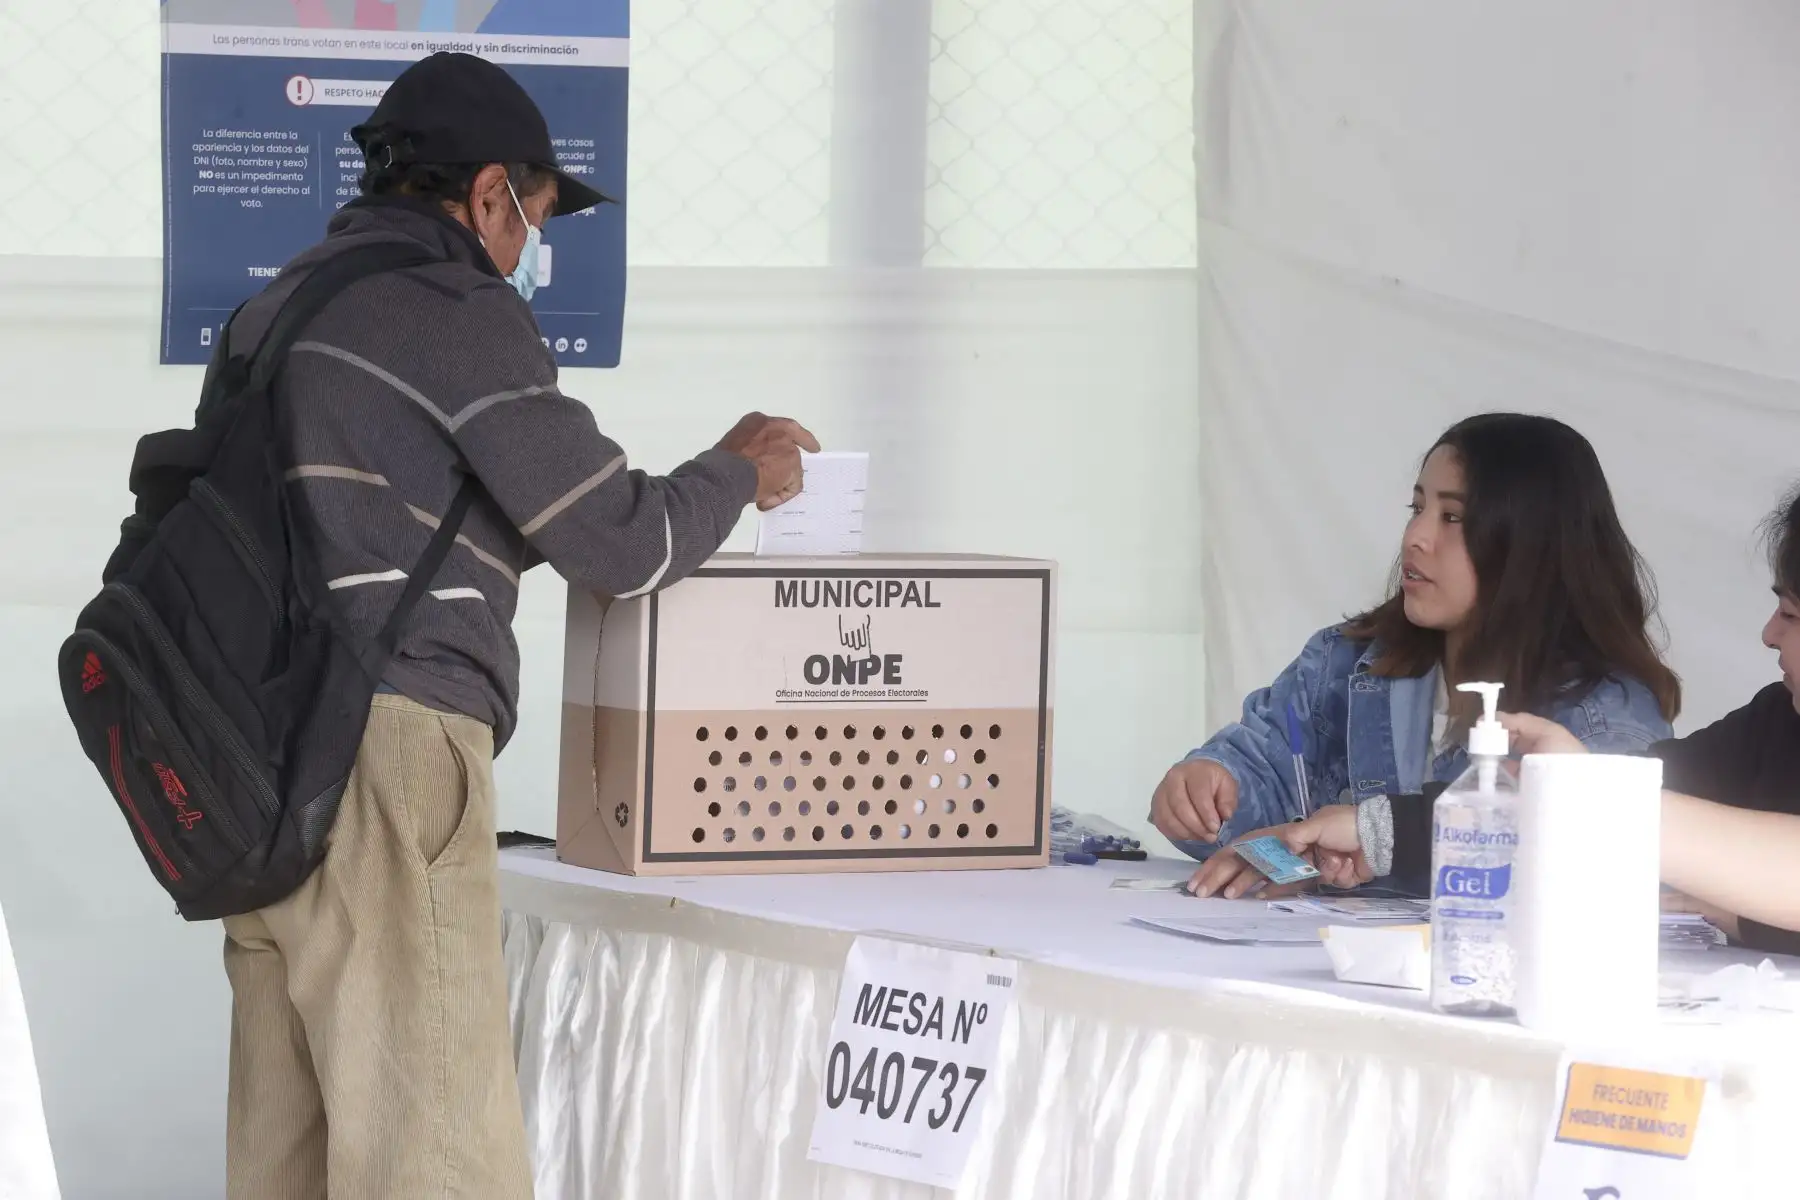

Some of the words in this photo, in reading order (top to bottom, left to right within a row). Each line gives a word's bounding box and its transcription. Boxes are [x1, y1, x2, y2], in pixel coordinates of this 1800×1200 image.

[213, 34, 230, 44] Las
[232, 35, 280, 47] personas
[283, 36, 310, 47] trans
[312, 37, 342, 48] votan
[344, 40, 358, 49] en
[359, 39, 382, 50] este
[384, 38, 409, 50] local
[411, 42, 424, 51] en
[426, 41, 473, 53] igualdad
[475, 45, 482, 54] y
[483, 42, 499, 53] sin
[501, 44, 579, 55] discriminación
[324, 88, 363, 97] RESPETO
[365, 89, 386, 98] HAC
[203, 129, 213, 138] La
[216, 129, 261, 139] diferencia
[263, 131, 287, 140] entre
[289, 130, 298, 140] la
[192, 143, 241, 153] apariencia
[243, 145, 250, 155] y
[251, 143, 265, 153] los
[266, 144, 293, 154] datos
[295, 144, 309, 154] del
[550, 139, 566, 147] ves
[568, 139, 594, 147] casos
[193, 156, 209, 165] DNI
[211, 155, 235, 168] (foto,
[237, 157, 274, 166] nombre
[275, 160, 281, 169] y
[283, 156, 308, 169] sexo)
[556, 152, 585, 160] acude
[587, 152, 595, 160] al
[563, 165, 587, 173] ONPE
[199, 170, 213, 179] NO
[228, 172, 239, 180] un
[241, 171, 303, 182] impedimento
[193, 185, 215, 195] para
[217, 185, 248, 195] ejercer
[251, 185, 259, 194] el
[261, 185, 300, 195] derecho
[301, 186, 310, 195] al
[336, 186, 348, 195] de
[240, 199, 263, 208] voto.
[774, 580, 941, 608] MUNICIPAL
[803, 653, 903, 685] ONPE
[776, 689, 803, 698] Oficina
[804, 689, 838, 697] Nacional
[840, 689, 850, 697] de
[852, 689, 886, 697] Procesos
[888, 688, 929, 697] Electorales
[1444, 869, 1493, 895] Gel
[853, 983, 944, 1040] MESA
[951, 999, 988, 1044] Nº
[826, 1041, 987, 1133] 040737
[1593, 1083, 1669, 1111] FRECUENTE
[1569, 1107, 1617, 1130] HIGIENE
[1618, 1115, 1634, 1131] DE
[1636, 1117, 1687, 1139] MANOS
